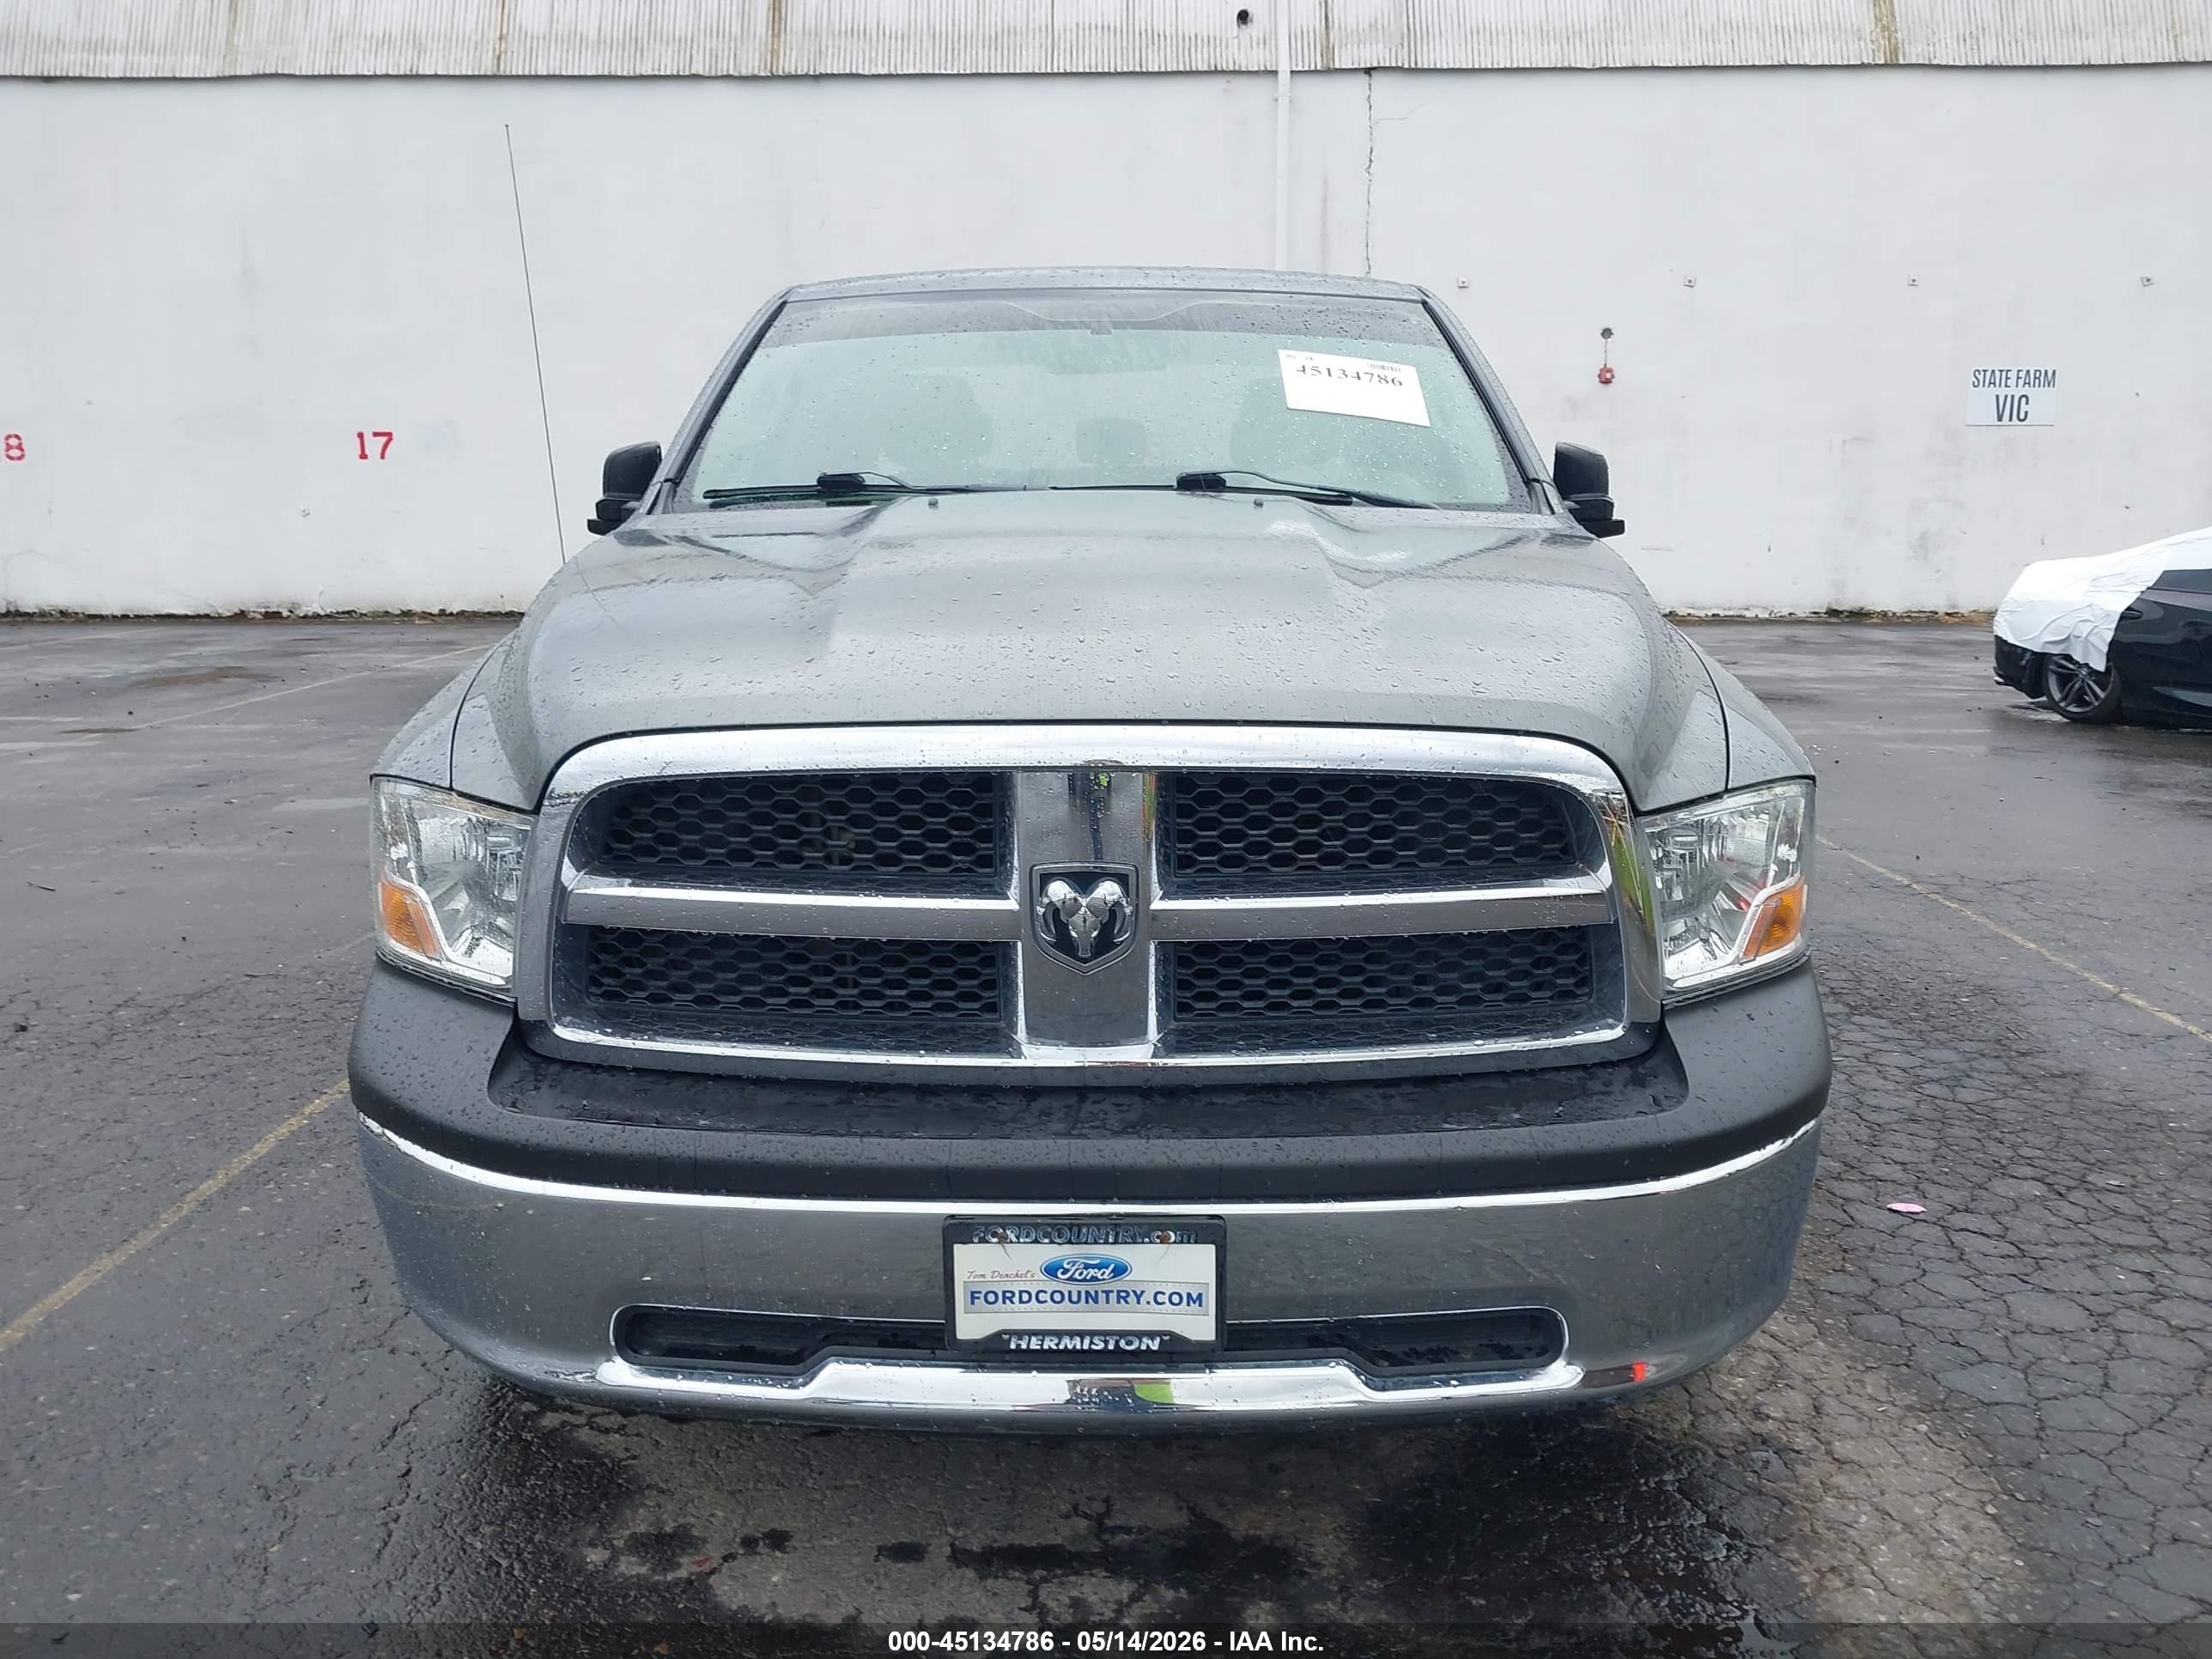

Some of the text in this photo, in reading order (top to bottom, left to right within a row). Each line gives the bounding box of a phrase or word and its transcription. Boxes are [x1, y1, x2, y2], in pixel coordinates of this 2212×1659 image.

[1296, 364, 1404, 387] 45134786
[1972, 368, 2057, 388] STATE FARM
[1995, 393, 2029, 422] VIC
[356, 431, 393, 460] 17
[967, 1270, 987, 1279] Tom
[1057, 1257, 1115, 1281] Ford
[969, 1289, 1204, 1308] FORDCOUNTRY.COM
[1009, 1334, 1163, 1351] HERMISTON
